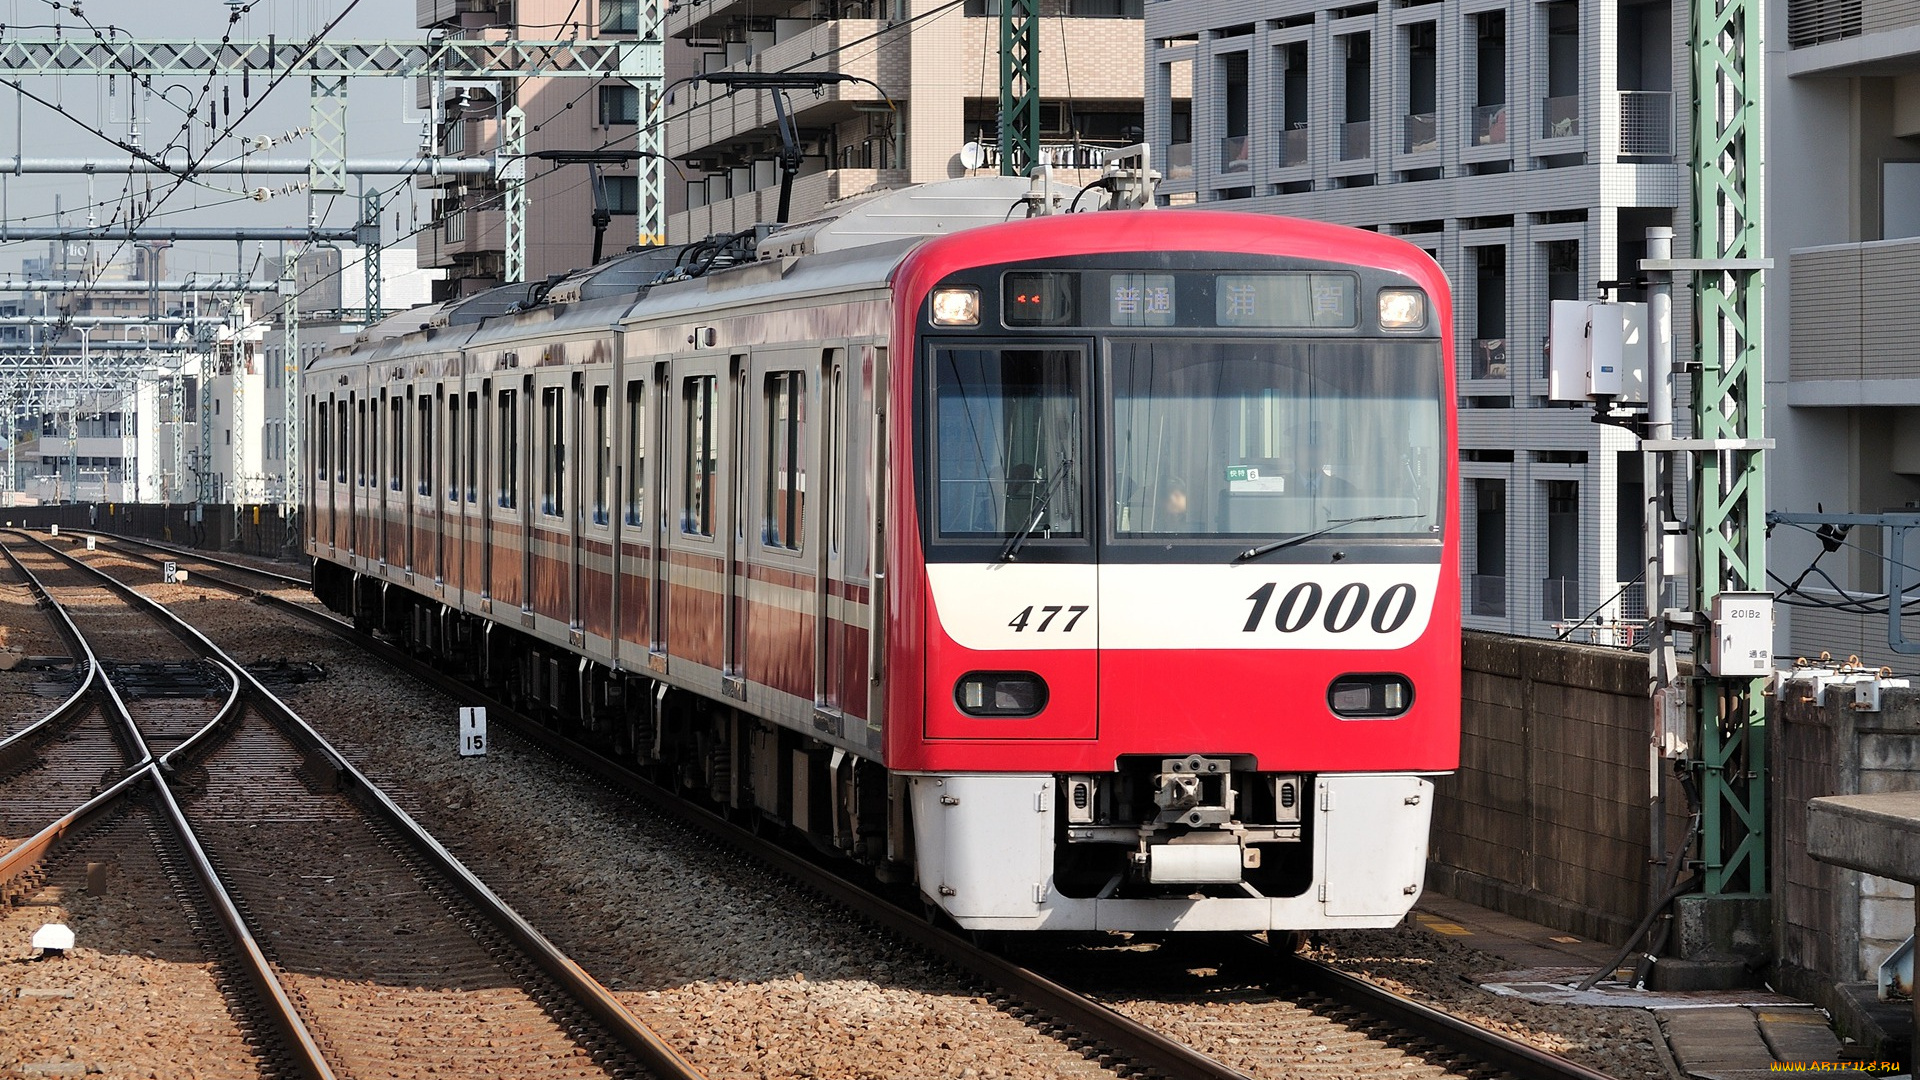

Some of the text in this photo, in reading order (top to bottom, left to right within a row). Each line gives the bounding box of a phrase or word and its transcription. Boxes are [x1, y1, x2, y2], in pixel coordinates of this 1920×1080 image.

[1115, 287, 1171, 314] 普通
[1226, 284, 1344, 316] 浦賀
[1249, 470, 1257, 479] 6
[165, 562, 175, 572] 15
[166, 573, 174, 584] K
[1242, 582, 1416, 633] 1000
[1008, 605, 1089, 632] 477
[467, 735, 483, 750] 15
